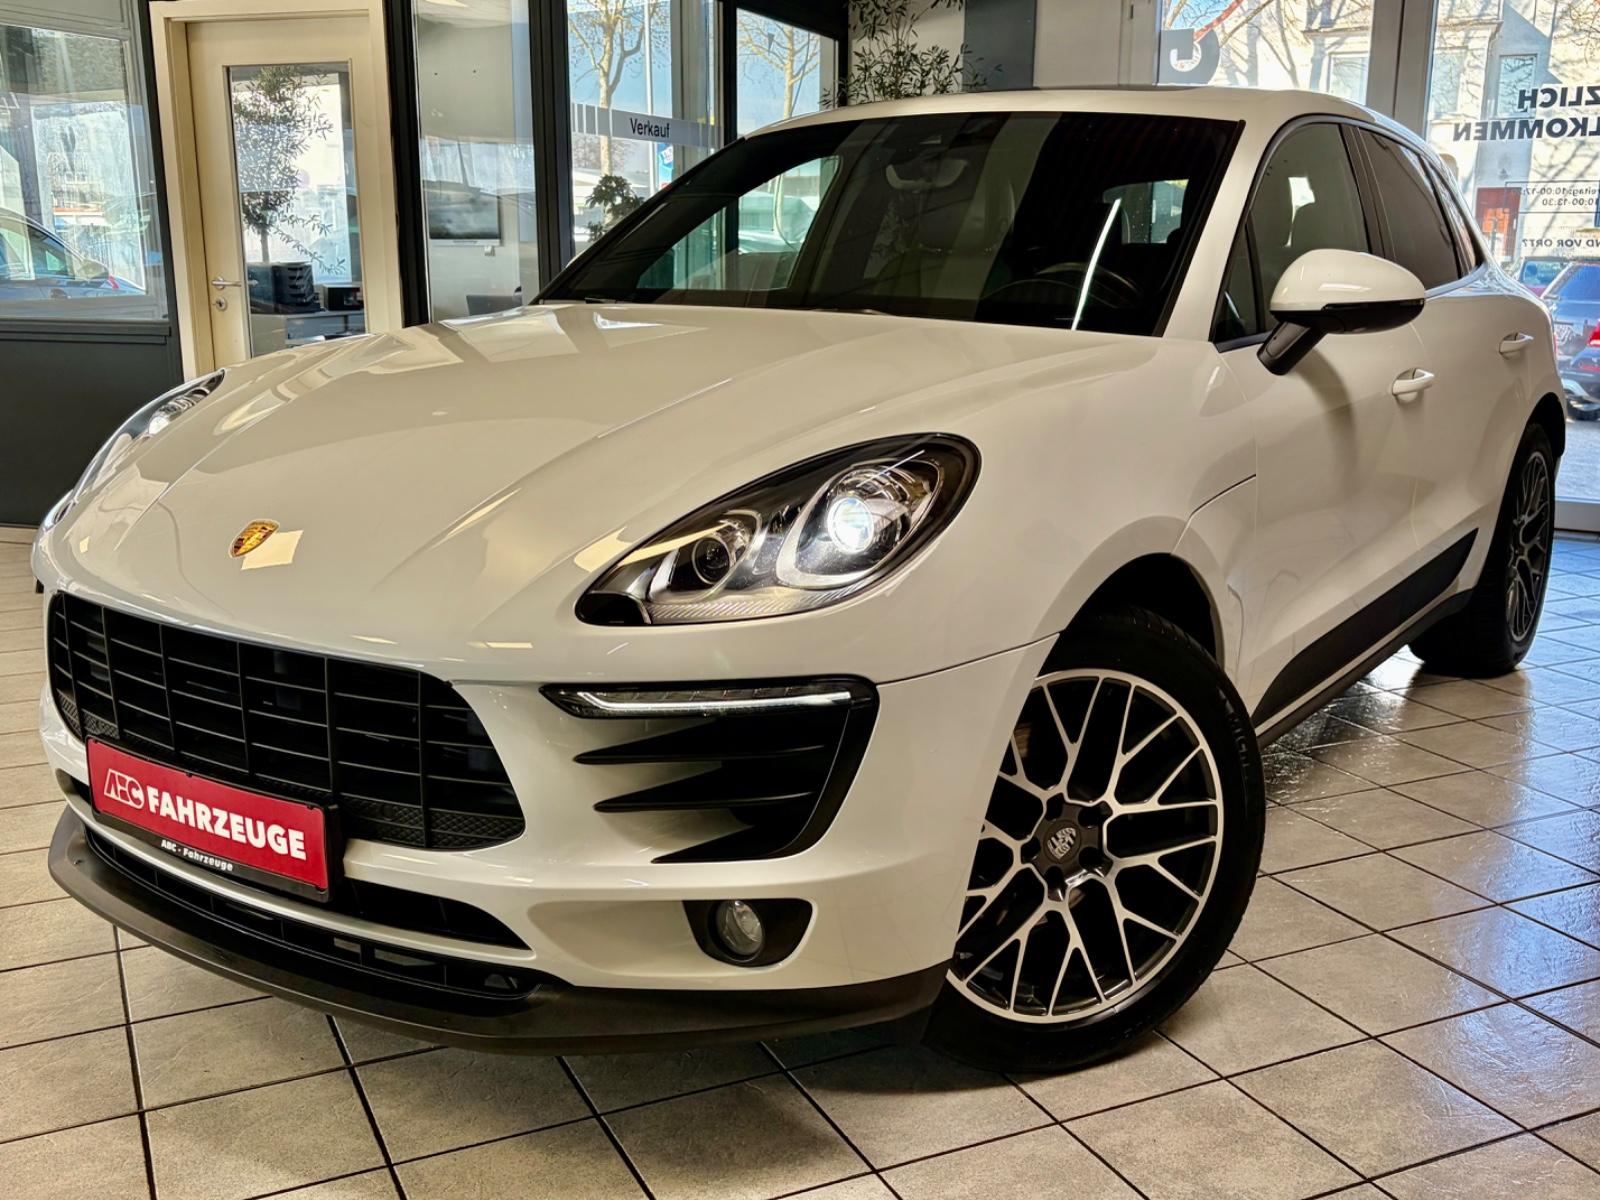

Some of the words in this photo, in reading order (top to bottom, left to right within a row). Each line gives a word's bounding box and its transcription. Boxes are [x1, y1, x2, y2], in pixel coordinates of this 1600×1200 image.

[629, 117, 670, 139] Verkauf
[146, 786, 307, 861] FAHRZEUGE
[182, 847, 233, 872] Fahrzeuge
